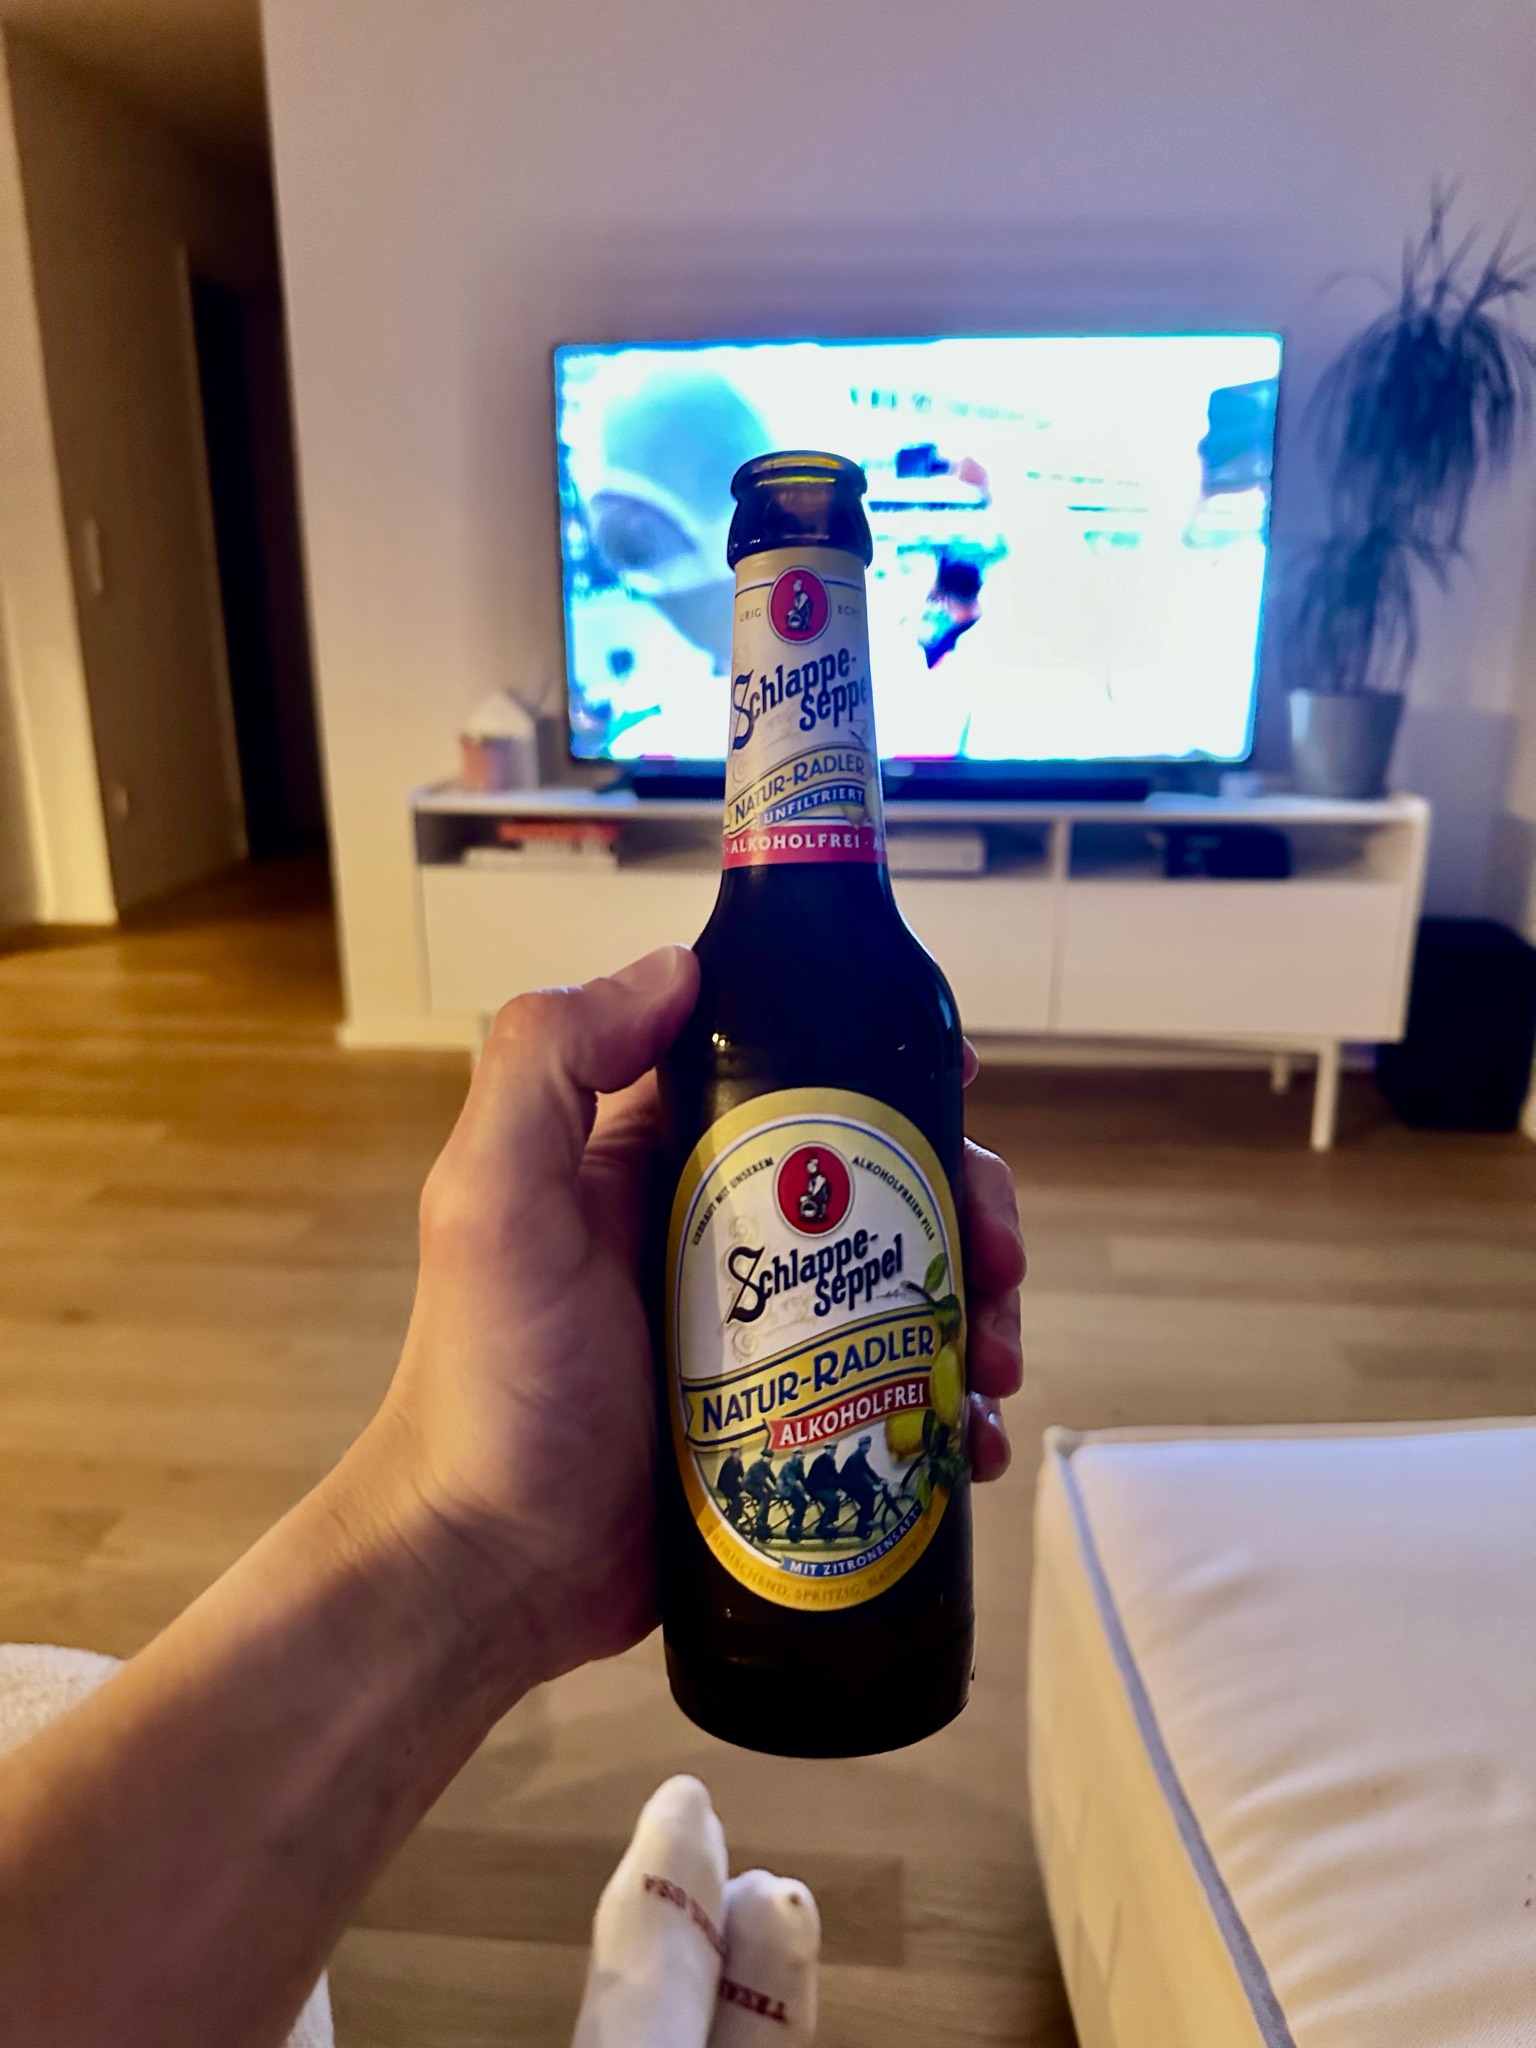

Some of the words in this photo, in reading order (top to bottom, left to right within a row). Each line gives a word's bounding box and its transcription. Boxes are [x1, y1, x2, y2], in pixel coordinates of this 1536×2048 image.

[740, 607, 762, 623] URIG
[735, 754, 865, 825] NATUR-RADLER
[763, 787, 864, 824] UNFILTRIERT
[730, 833, 860, 854] ALKOHOLFREI
[730, 1156, 775, 1190] UNSEREM
[852, 1155, 926, 1220] ALKOHOLFREIEN
[921, 1217, 935, 1241] PILS
[702, 1325, 934, 1433] NATUR-RADLER
[779, 1383, 924, 1446] ALKOHOLFREI
[789, 1560, 818, 1576] MIT
